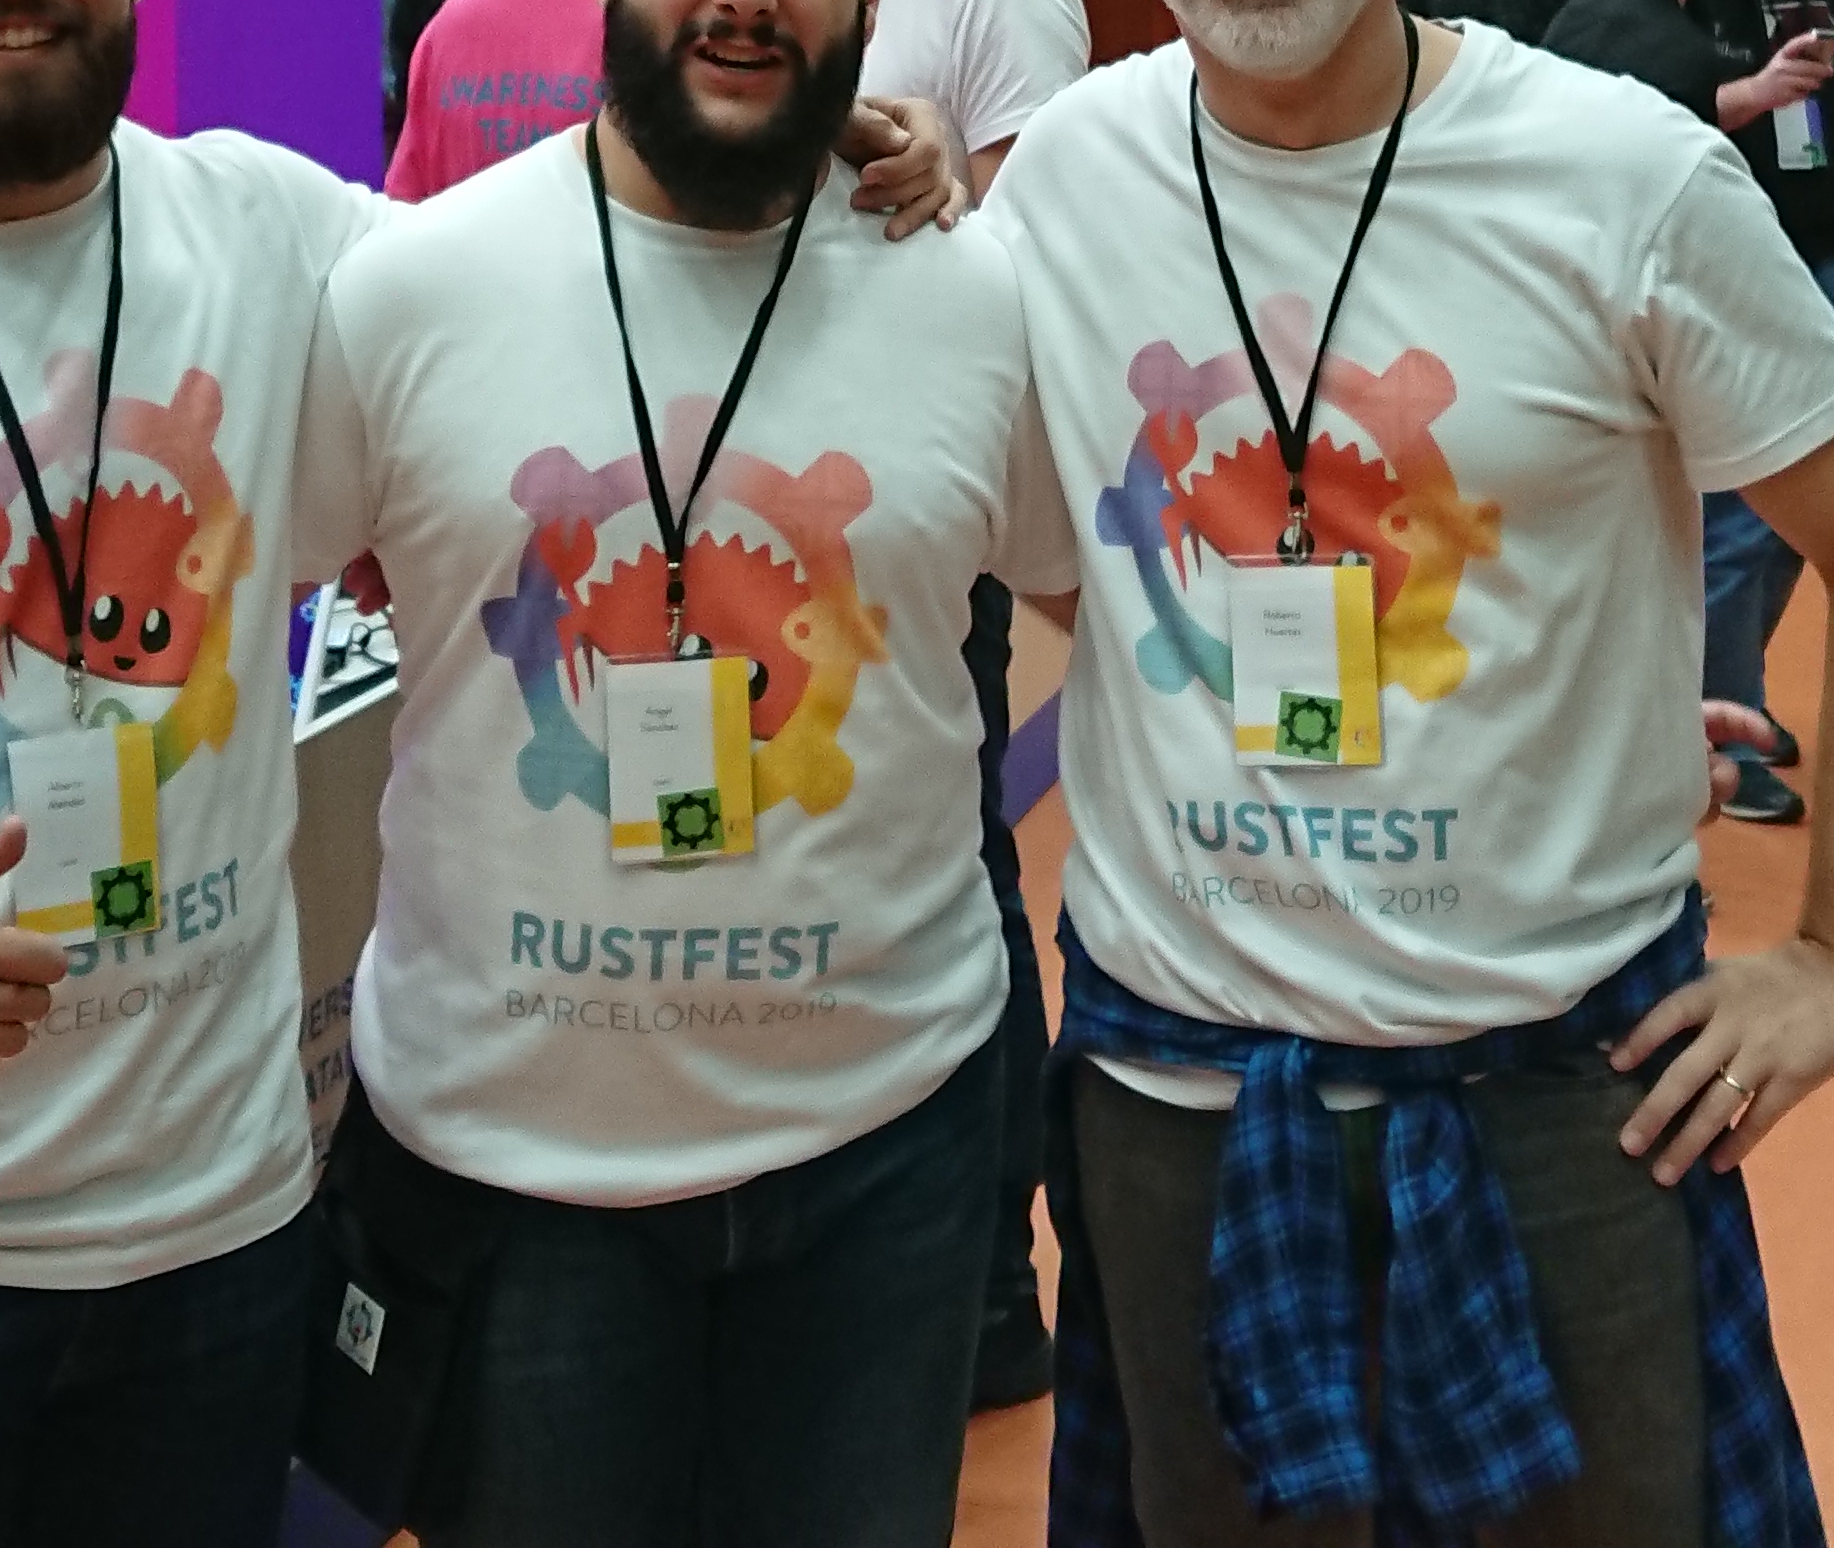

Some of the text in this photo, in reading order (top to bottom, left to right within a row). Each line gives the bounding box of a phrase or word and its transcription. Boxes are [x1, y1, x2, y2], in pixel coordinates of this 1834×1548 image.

[1377, 884, 1461, 915] 2019
[510, 909, 840, 982] RUSTFEST
[505, 989, 747, 1035] BARCELONA
